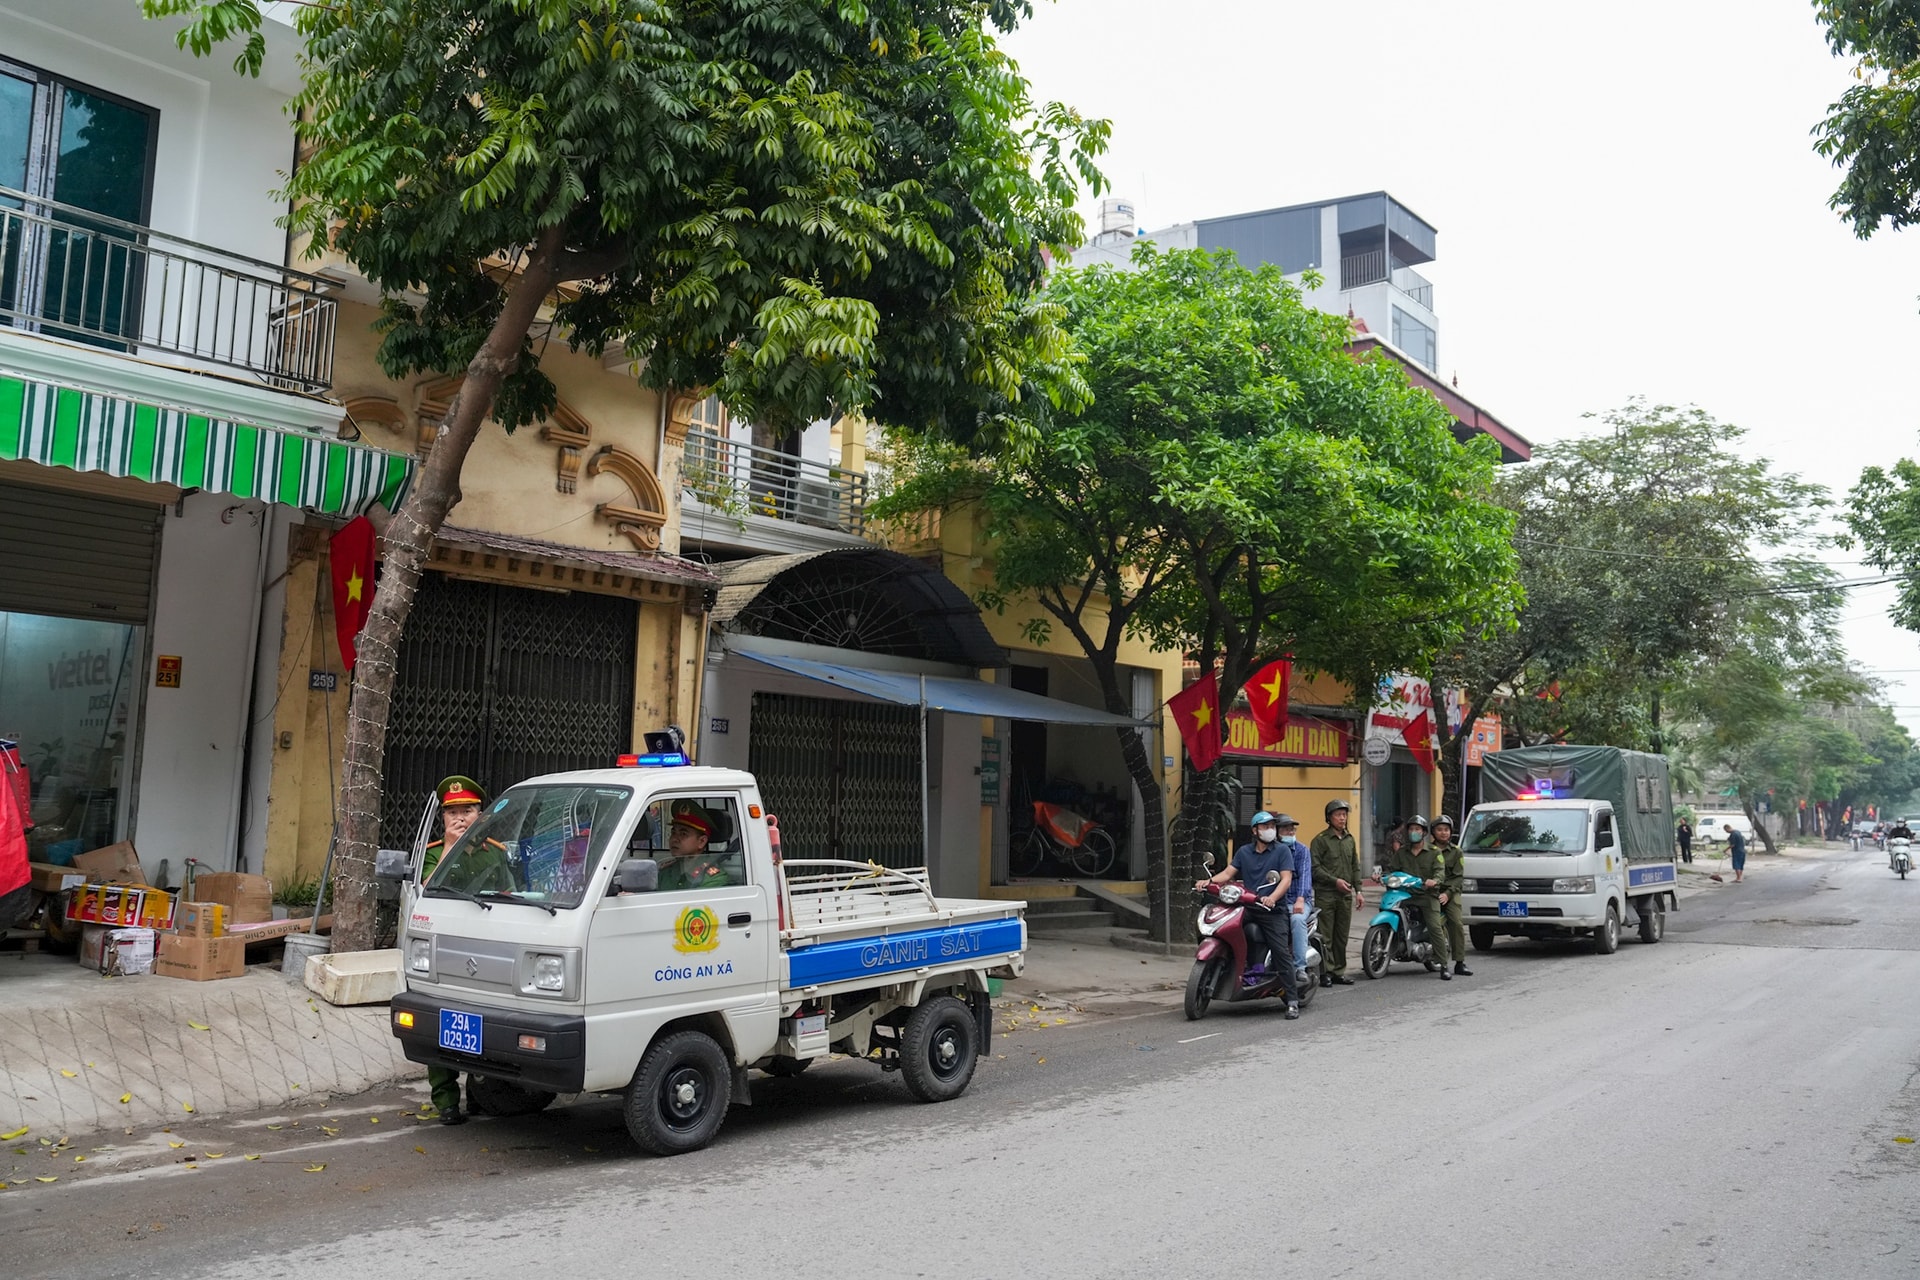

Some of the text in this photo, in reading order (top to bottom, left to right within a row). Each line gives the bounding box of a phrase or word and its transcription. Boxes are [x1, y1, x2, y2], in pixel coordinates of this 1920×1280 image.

[47, 648, 113, 691] viettel
[158, 672, 179, 683] 251
[312, 674, 335, 688] 253
[712, 720, 728, 732] 255
[1308, 724, 1341, 758] DÂN
[412, 914, 430, 922] SUPER
[268, 928, 276, 936] in
[277, 924, 301, 934] Made
[861, 928, 983, 968] CẢNH SÁT
[655, 960, 734, 982] CÔNG AN XÃ
[451, 1013, 470, 1032] 29A
[443, 1029, 478, 1051] 029.32
